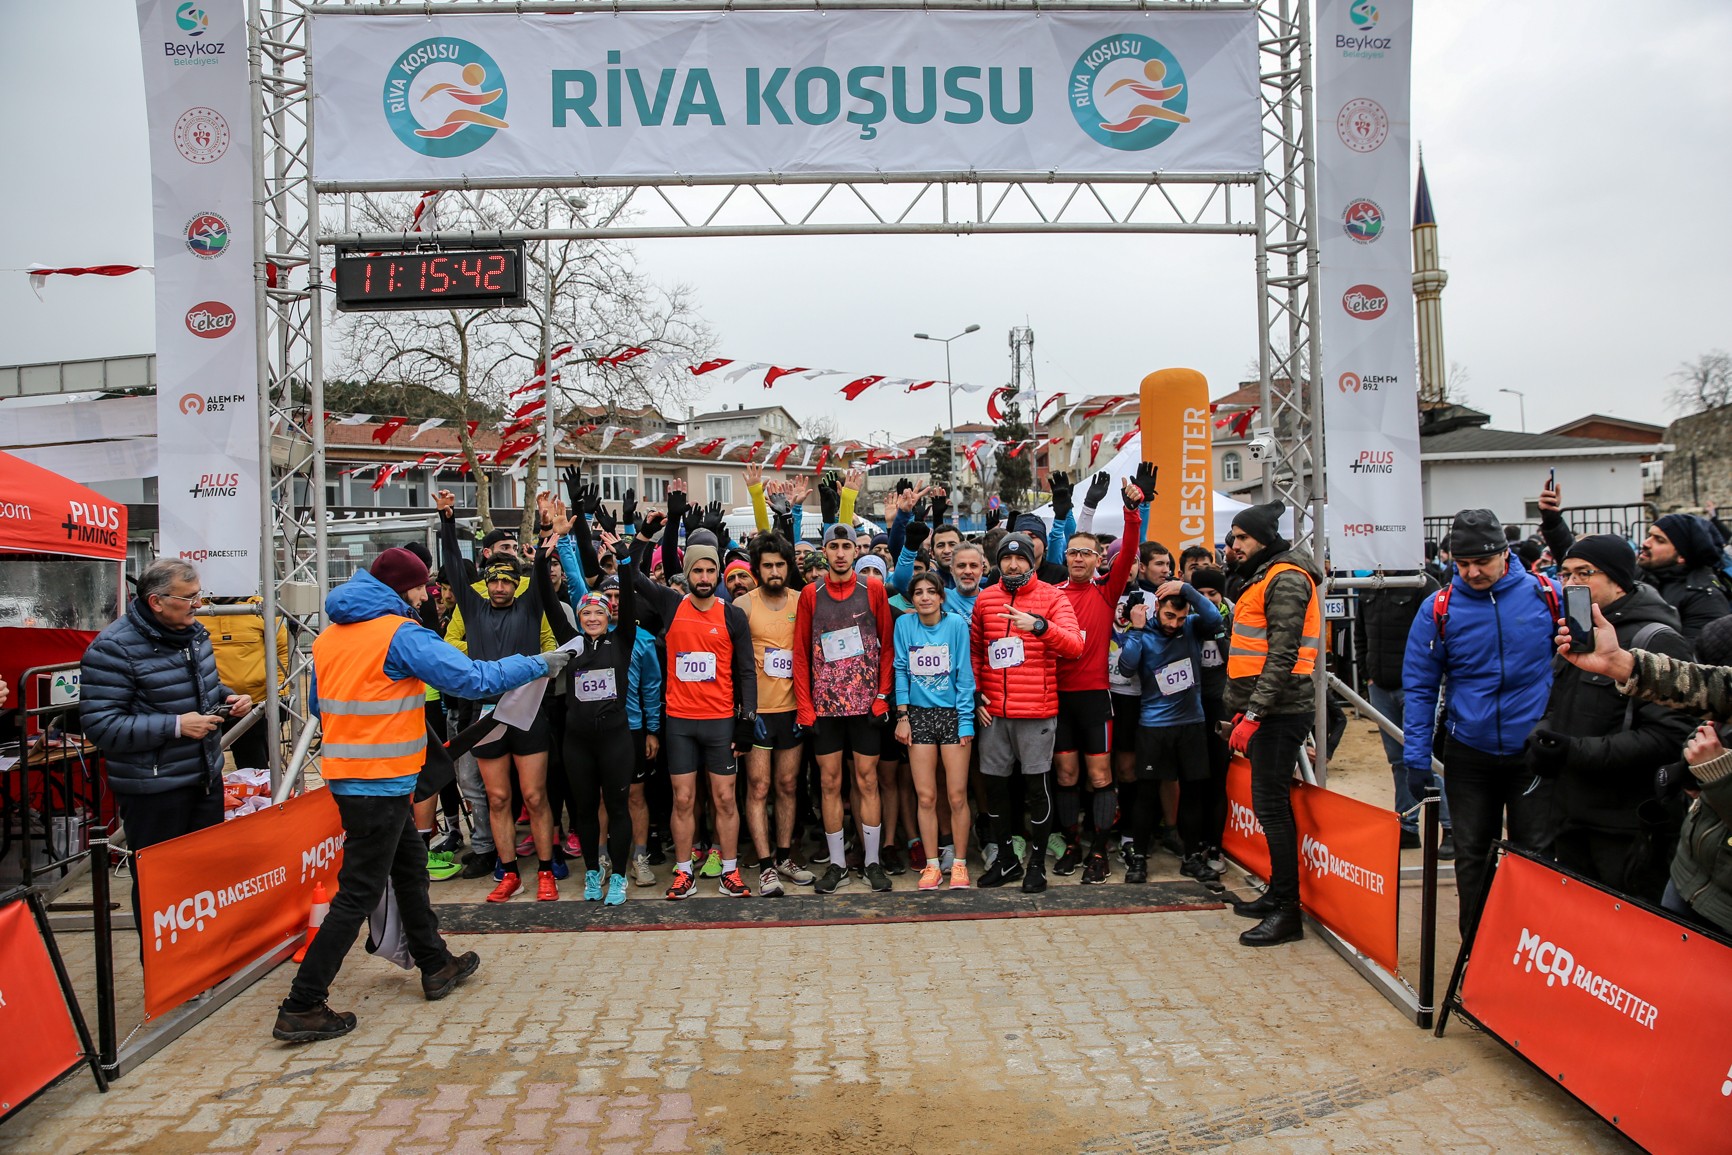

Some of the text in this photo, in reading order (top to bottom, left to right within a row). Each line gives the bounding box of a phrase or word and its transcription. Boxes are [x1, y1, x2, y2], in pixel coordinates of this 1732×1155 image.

[164, 41, 226, 58] Beykoz
[1335, 34, 1392, 51] Beykoz
[173, 57, 219, 66] Belediyesi
[387, 43, 460, 114] RİVA KOŞUSU
[1072, 40, 1142, 108] RİVA KOŞUSU
[552, 49, 1034, 142] RİVA KOŞUSU
[364, 255, 505, 294] 11:15:42
[1352, 297, 1385, 313] eker
[197, 314, 233, 331] eker
[1362, 375, 1398, 383] ALEM FM
[1362, 383, 1378, 391] 89.2
[207, 394, 245, 404] ALEM FM
[206, 403, 225, 412] 89.2
[1359, 450, 1394, 464] PLUS
[200, 473, 239, 489] PLUS
[69, 500, 120, 530] PLUS
[1343, 523, 1406, 536] MCR RACESETTER
[208, 550, 248, 558] RACESETTER
[837, 639, 846, 651] 3
[994, 646, 1015, 660] 697
[684, 661, 707, 674] 700
[772, 657, 793, 671] 689
[917, 655, 941, 667] 680
[1166, 669, 1188, 685] 679
[582, 679, 608, 693] 634
[301, 836, 336, 885] MCR
[1301, 833, 1384, 895] MCR RACESETTER
[153, 865, 287, 952] MCR RACESETTER
[1512, 927, 1659, 1030] MCR RACESETTER
